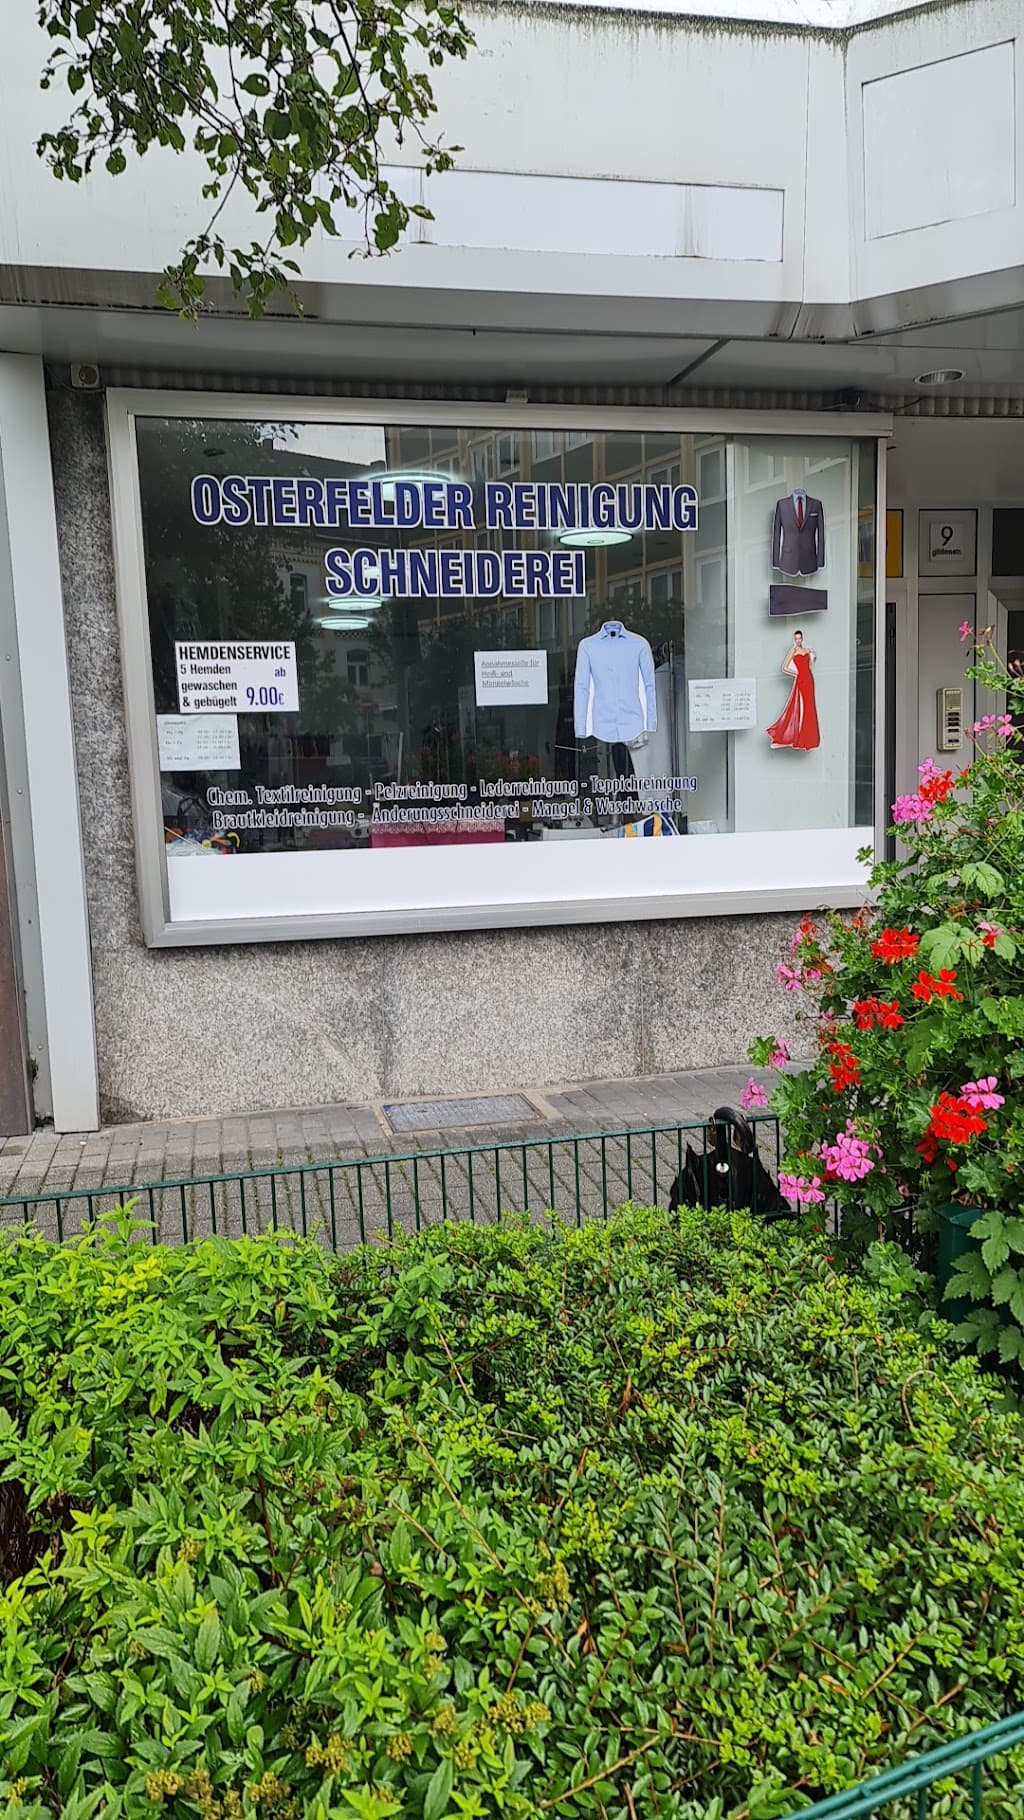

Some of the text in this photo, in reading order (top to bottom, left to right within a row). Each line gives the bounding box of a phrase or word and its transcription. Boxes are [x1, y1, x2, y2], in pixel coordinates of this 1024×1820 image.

[191, 474, 698, 531] OSTERFELDER REINIGUNG
[941, 526, 953, 546] 9
[325, 547, 586, 598] SCHNEIDEREI
[179, 646, 291, 660] HEMDENSERVICE
[180, 664, 231, 675] 5 Hemden
[274, 667, 286, 677] ab
[181, 680, 237, 693] gewaschen
[182, 696, 237, 709] & gebügelt
[207, 786, 253, 805] Chem.
[255, 784, 361, 805] Textilreinigung
[374, 780, 468, 801] Pelzreinigung
[479, 777, 579, 798] Lederreinigung
[590, 774, 697, 795] Teppichreinigung
[212, 807, 356, 829] Brautkleidreinigung
[371, 802, 520, 825] Änderungsschneiderei
[532, 798, 580, 819] Mangel
[583, 797, 593, 815] &
